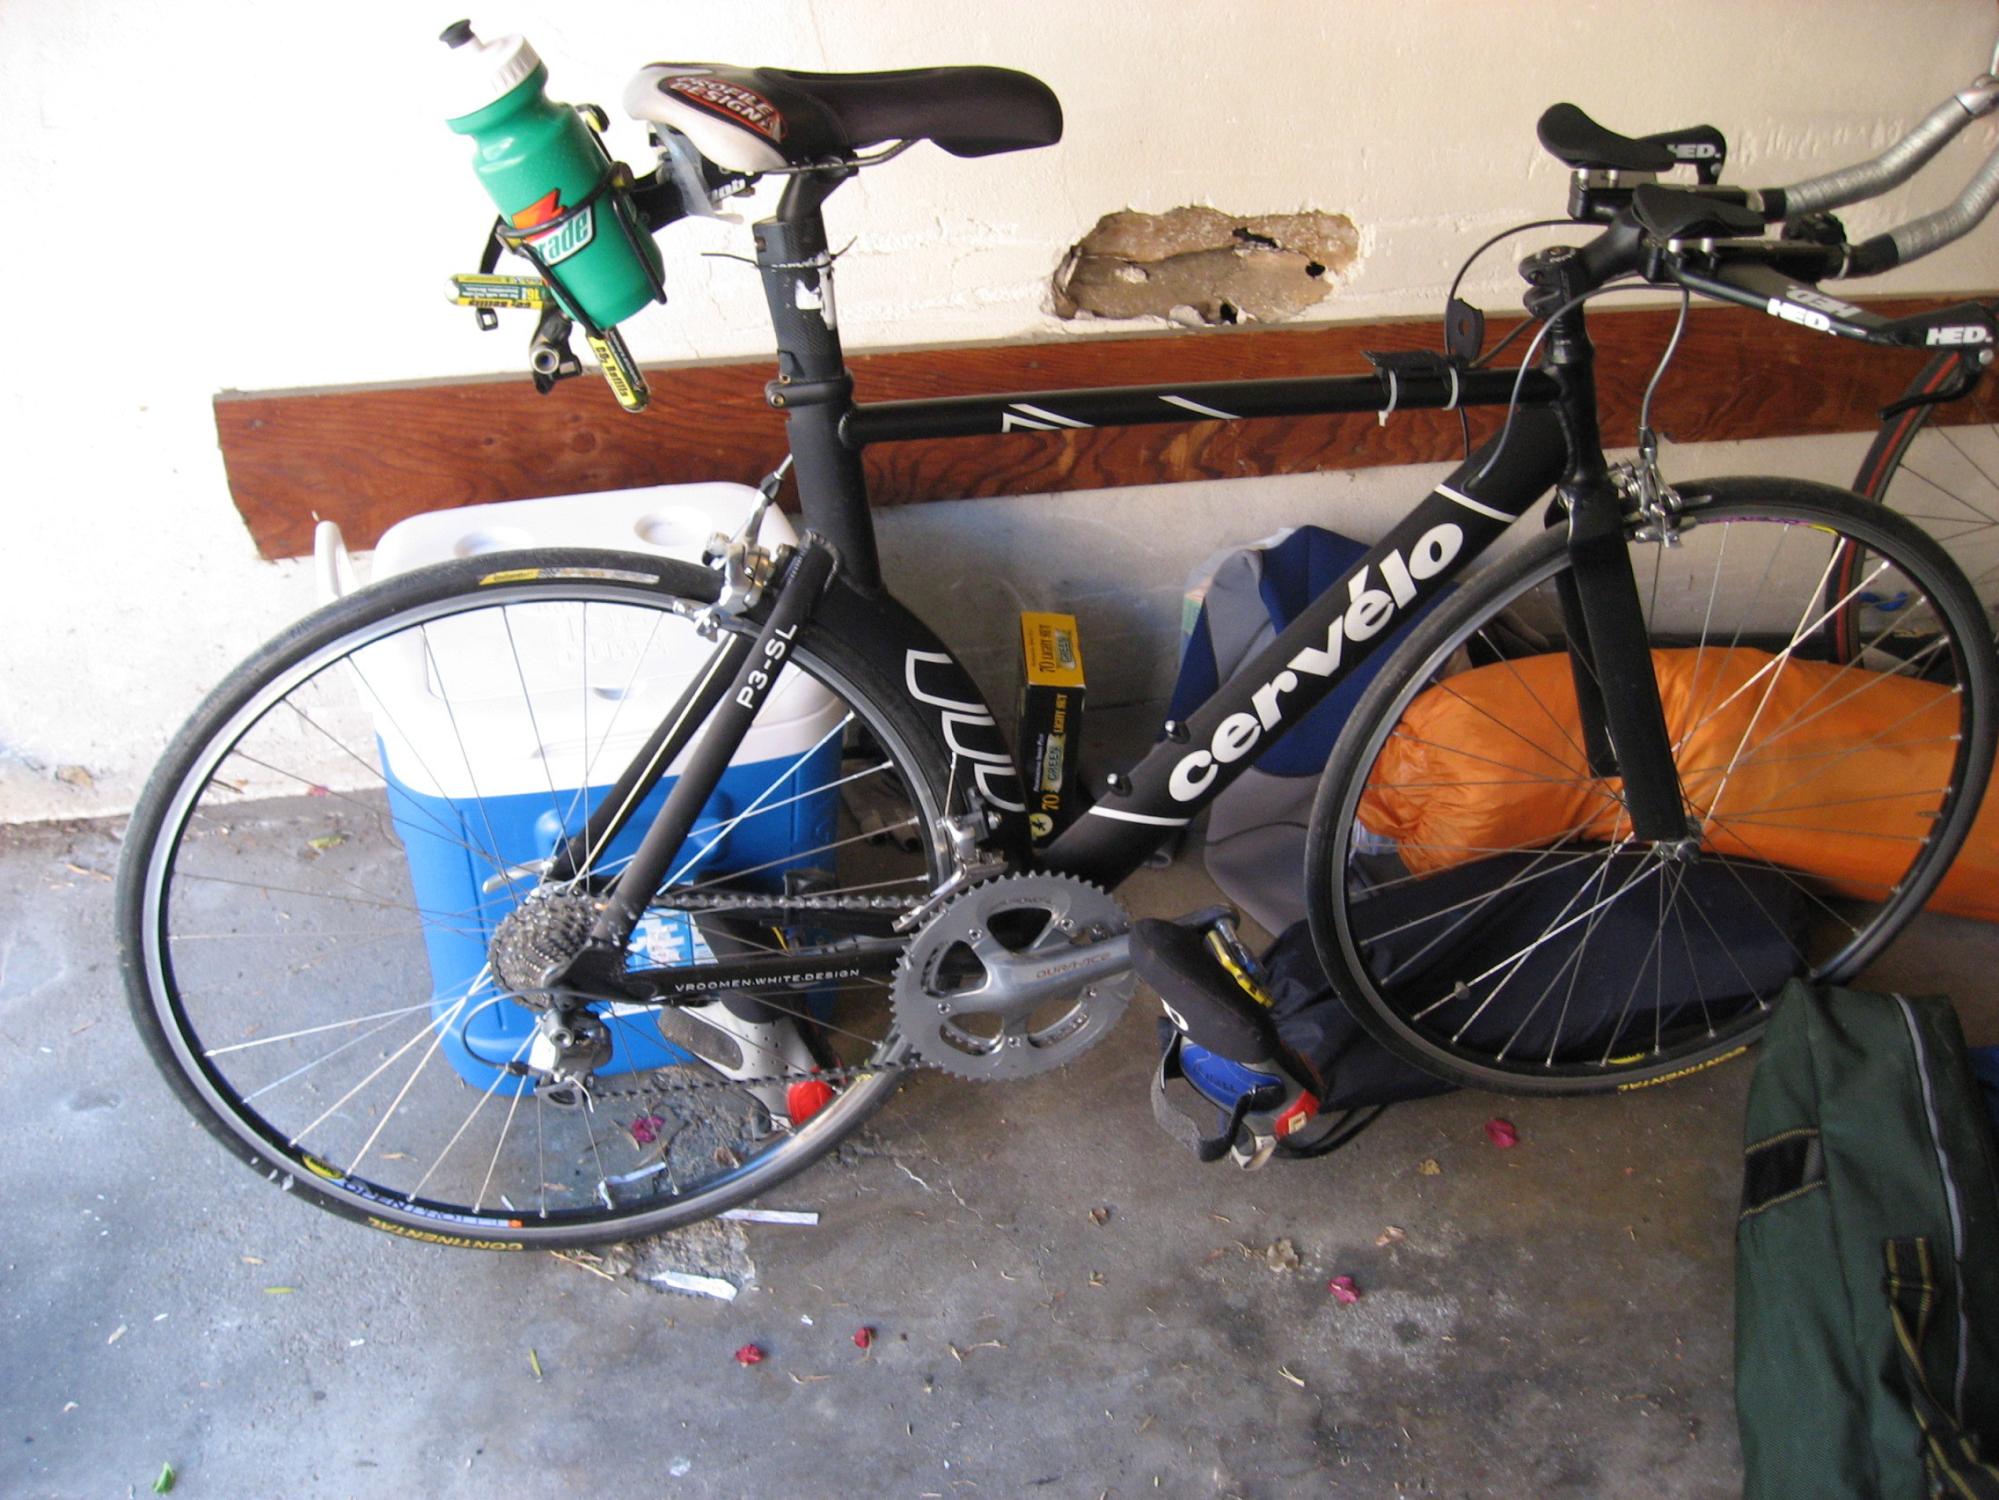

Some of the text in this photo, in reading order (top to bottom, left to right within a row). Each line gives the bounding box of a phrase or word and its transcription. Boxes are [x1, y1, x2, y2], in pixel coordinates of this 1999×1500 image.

[1767, 298, 1837, 336] HED.
[1926, 325, 1993, 346] HED.
[736, 624, 798, 709] P3-SL
[1168, 523, 1464, 802] cervélo
[1041, 793, 1060, 810] 70
[367, 1216, 524, 1251] CONTINENTAL
